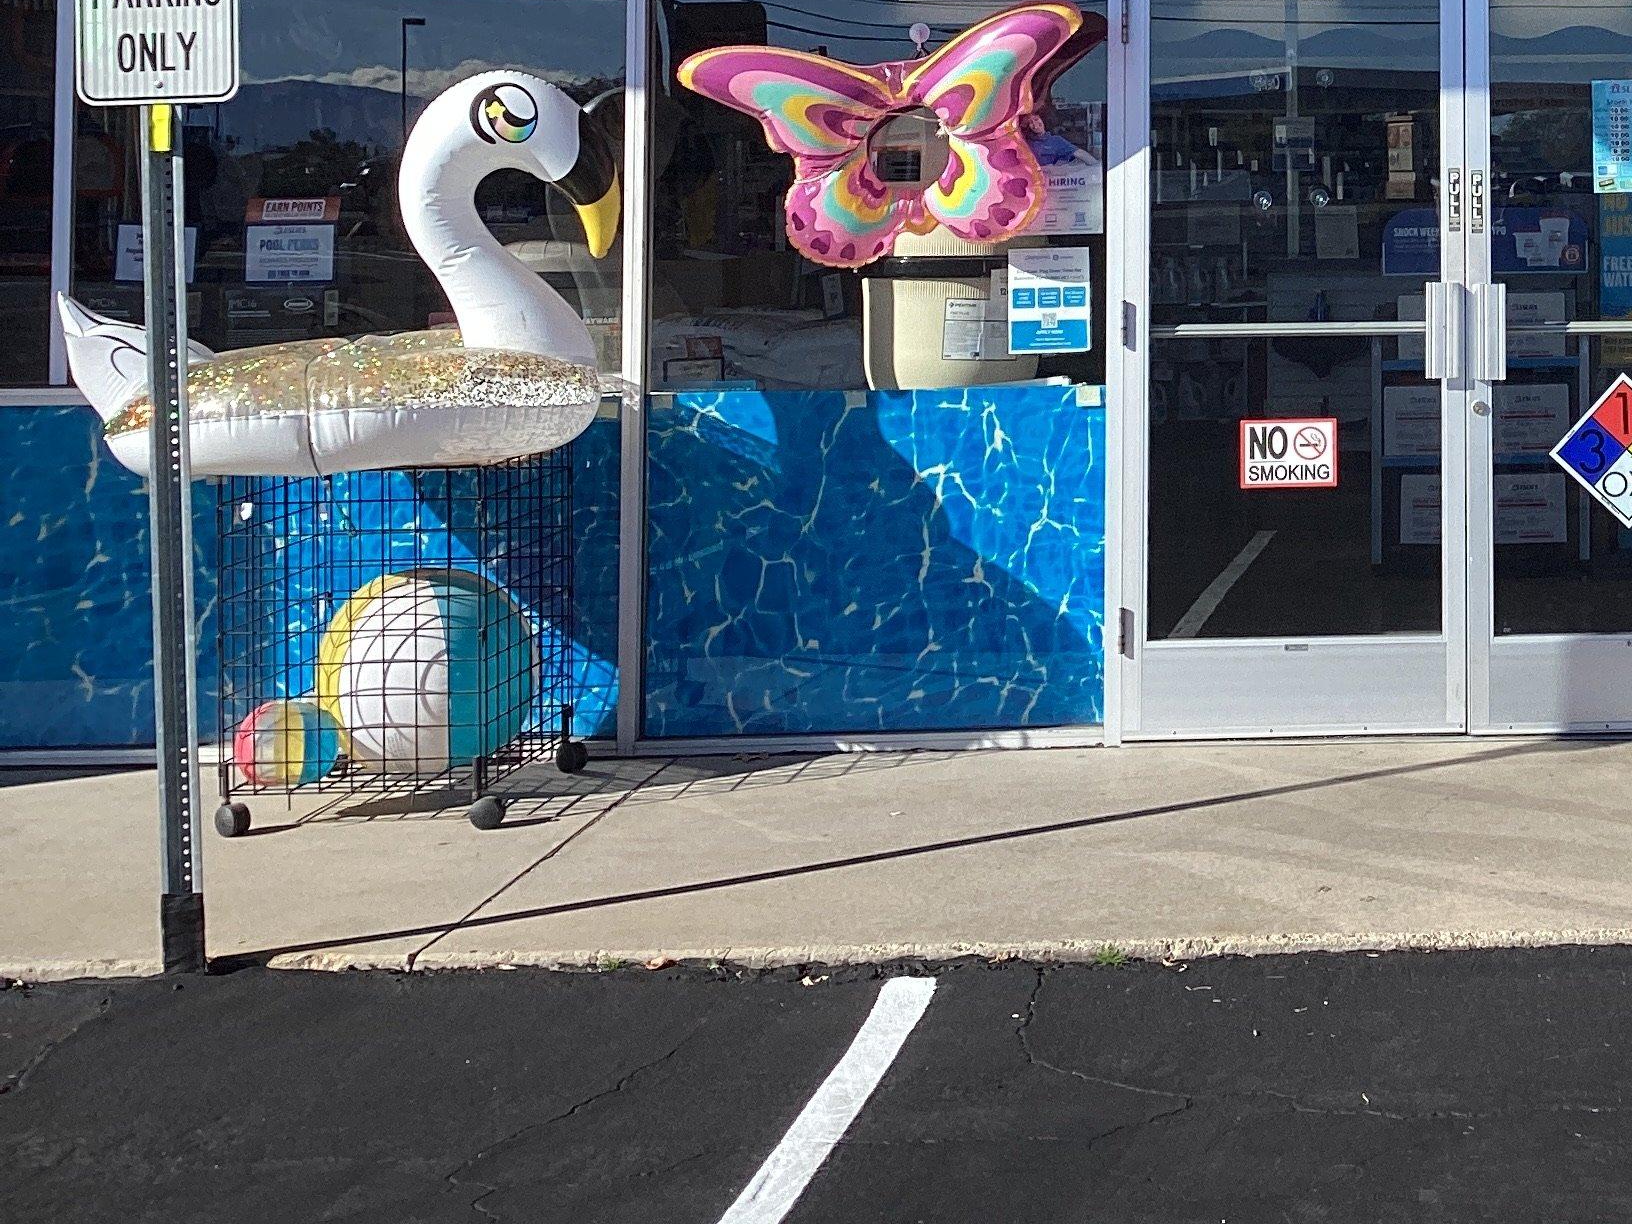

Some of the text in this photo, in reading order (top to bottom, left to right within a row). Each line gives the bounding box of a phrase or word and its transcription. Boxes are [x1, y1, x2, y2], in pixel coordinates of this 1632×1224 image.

[117, 32, 197, 73] ONLY
[1048, 177, 1086, 187] HIRING
[1449, 172, 1460, 217] PULL
[1472, 174, 1483, 219] PULL
[265, 201, 324, 212] EARN POINTS
[586, 317, 619, 325] AYWARD
[1614, 392, 1629, 435] 1
[1248, 425, 1288, 460] NO
[1579, 428, 1606, 474] 3
[1248, 463, 1330, 482] SMOKING
